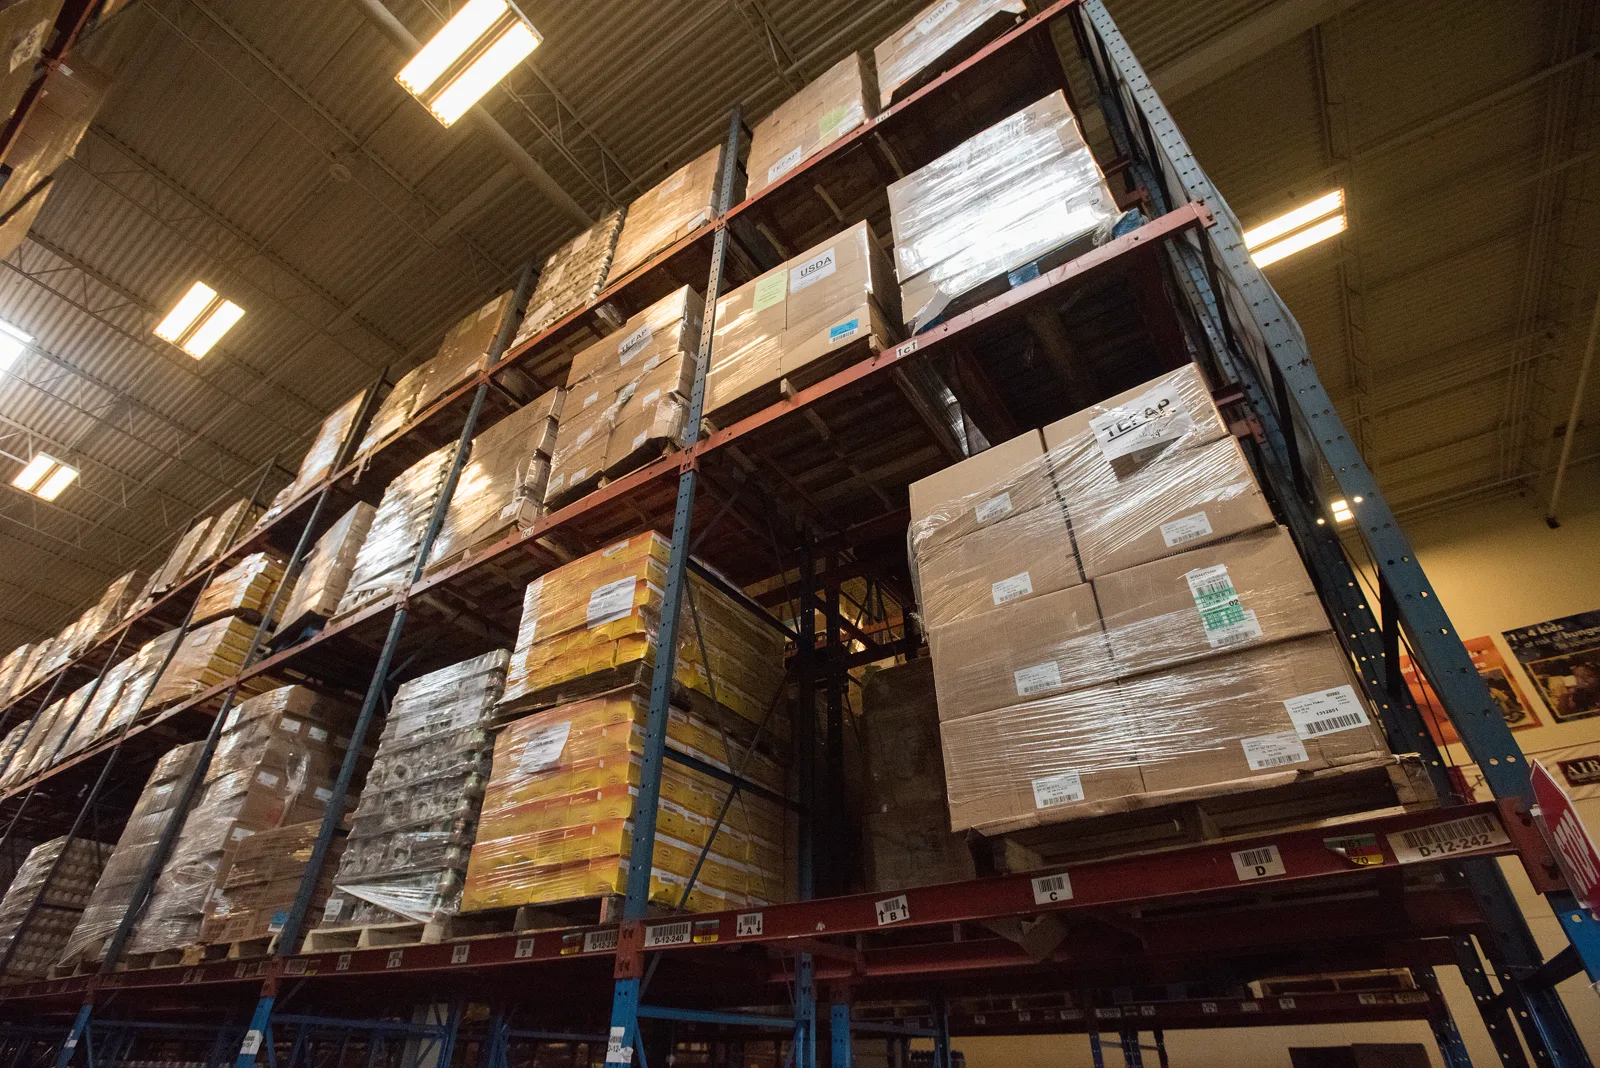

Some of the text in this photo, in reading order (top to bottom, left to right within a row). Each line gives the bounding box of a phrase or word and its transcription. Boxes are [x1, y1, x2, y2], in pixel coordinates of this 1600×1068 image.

[801, 256, 832, 277] USDA
[621, 329, 647, 352] TEFAP
[1228, 599, 1239, 607] 02
[1418, 834, 1493, 858] D-12-242
[1255, 865, 1267, 877] D
[1050, 892, 1058, 901] C
[890, 912, 897, 921] B
[654, 934, 684, 945] D-12-240
